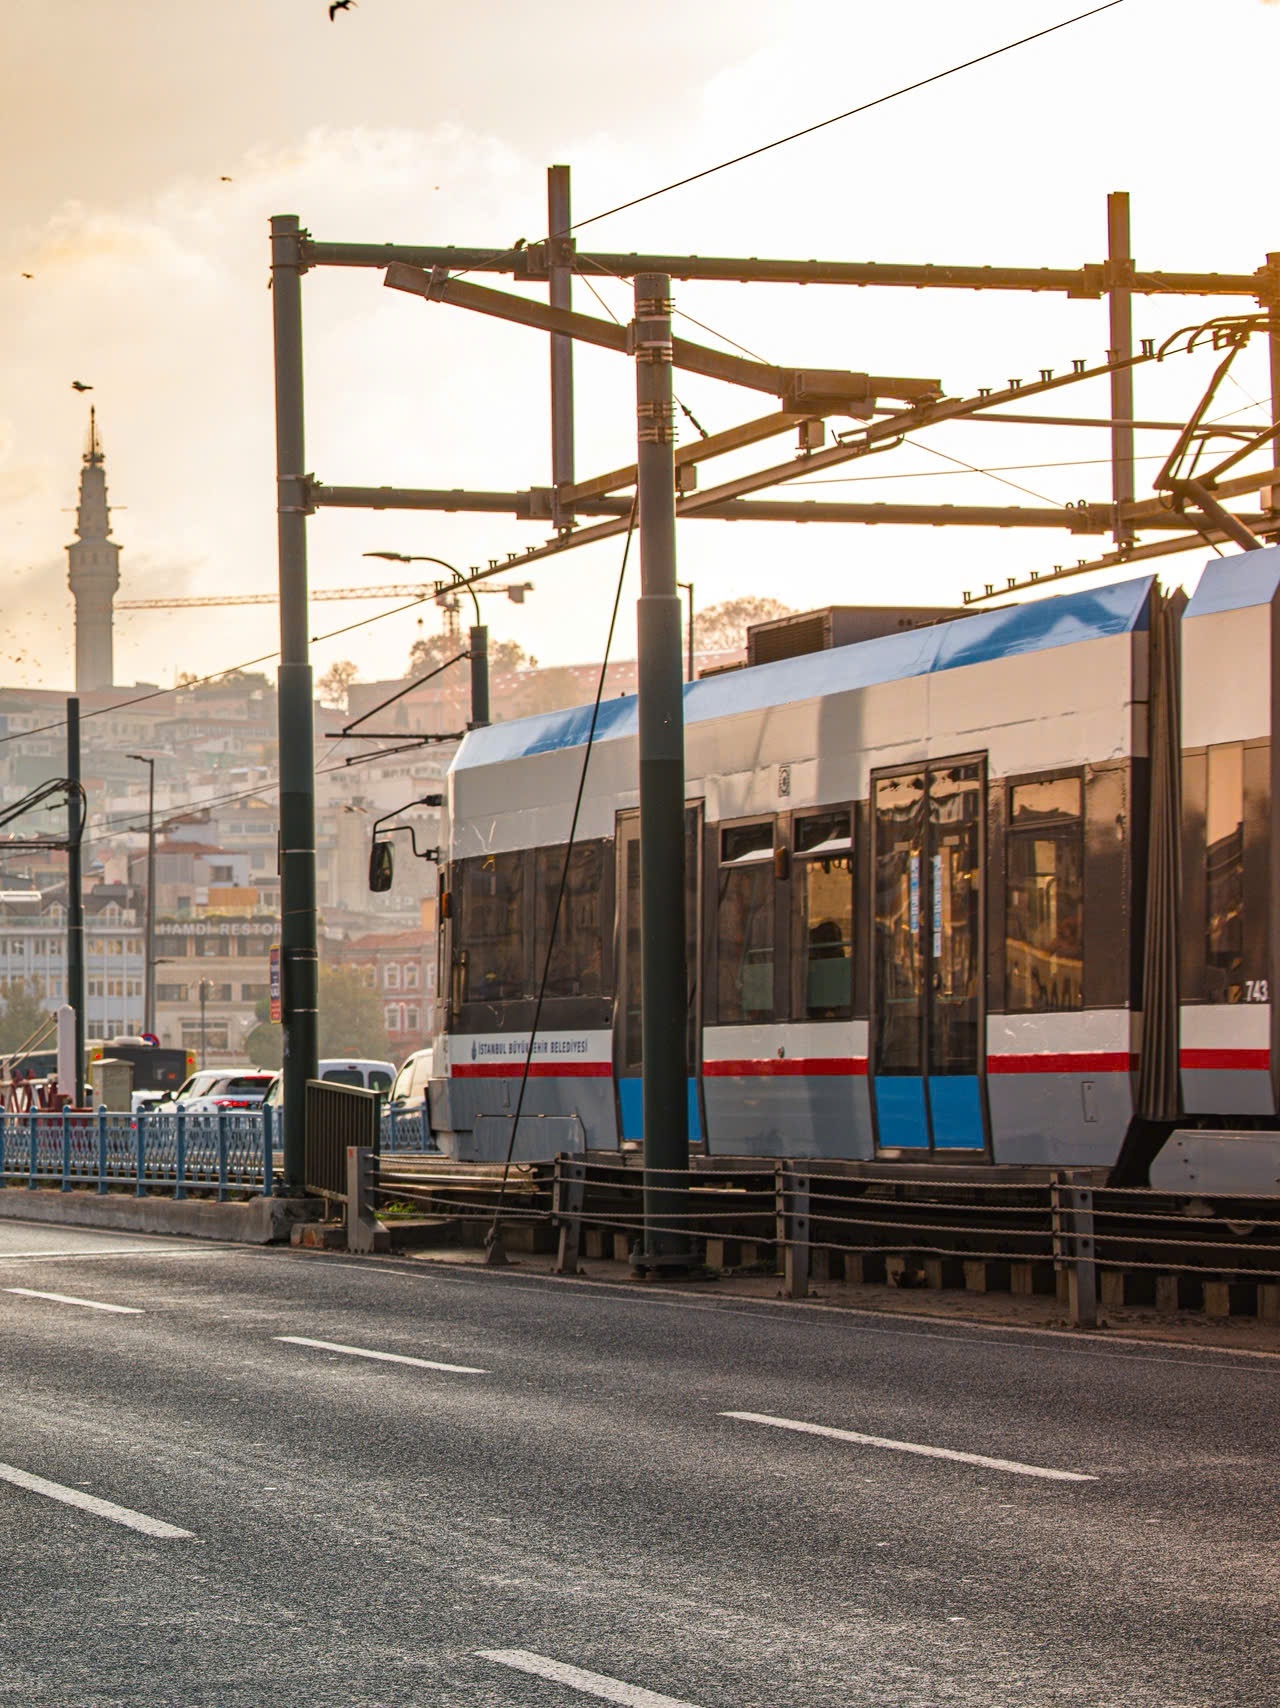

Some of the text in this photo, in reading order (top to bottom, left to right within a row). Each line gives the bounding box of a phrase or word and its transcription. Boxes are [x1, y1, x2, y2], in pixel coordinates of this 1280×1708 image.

[219, 922, 281, 935] RESTOR
[1245, 980, 1268, 1002] 743
[509, 1040, 548, 1054] BÜYÜKEHİR
